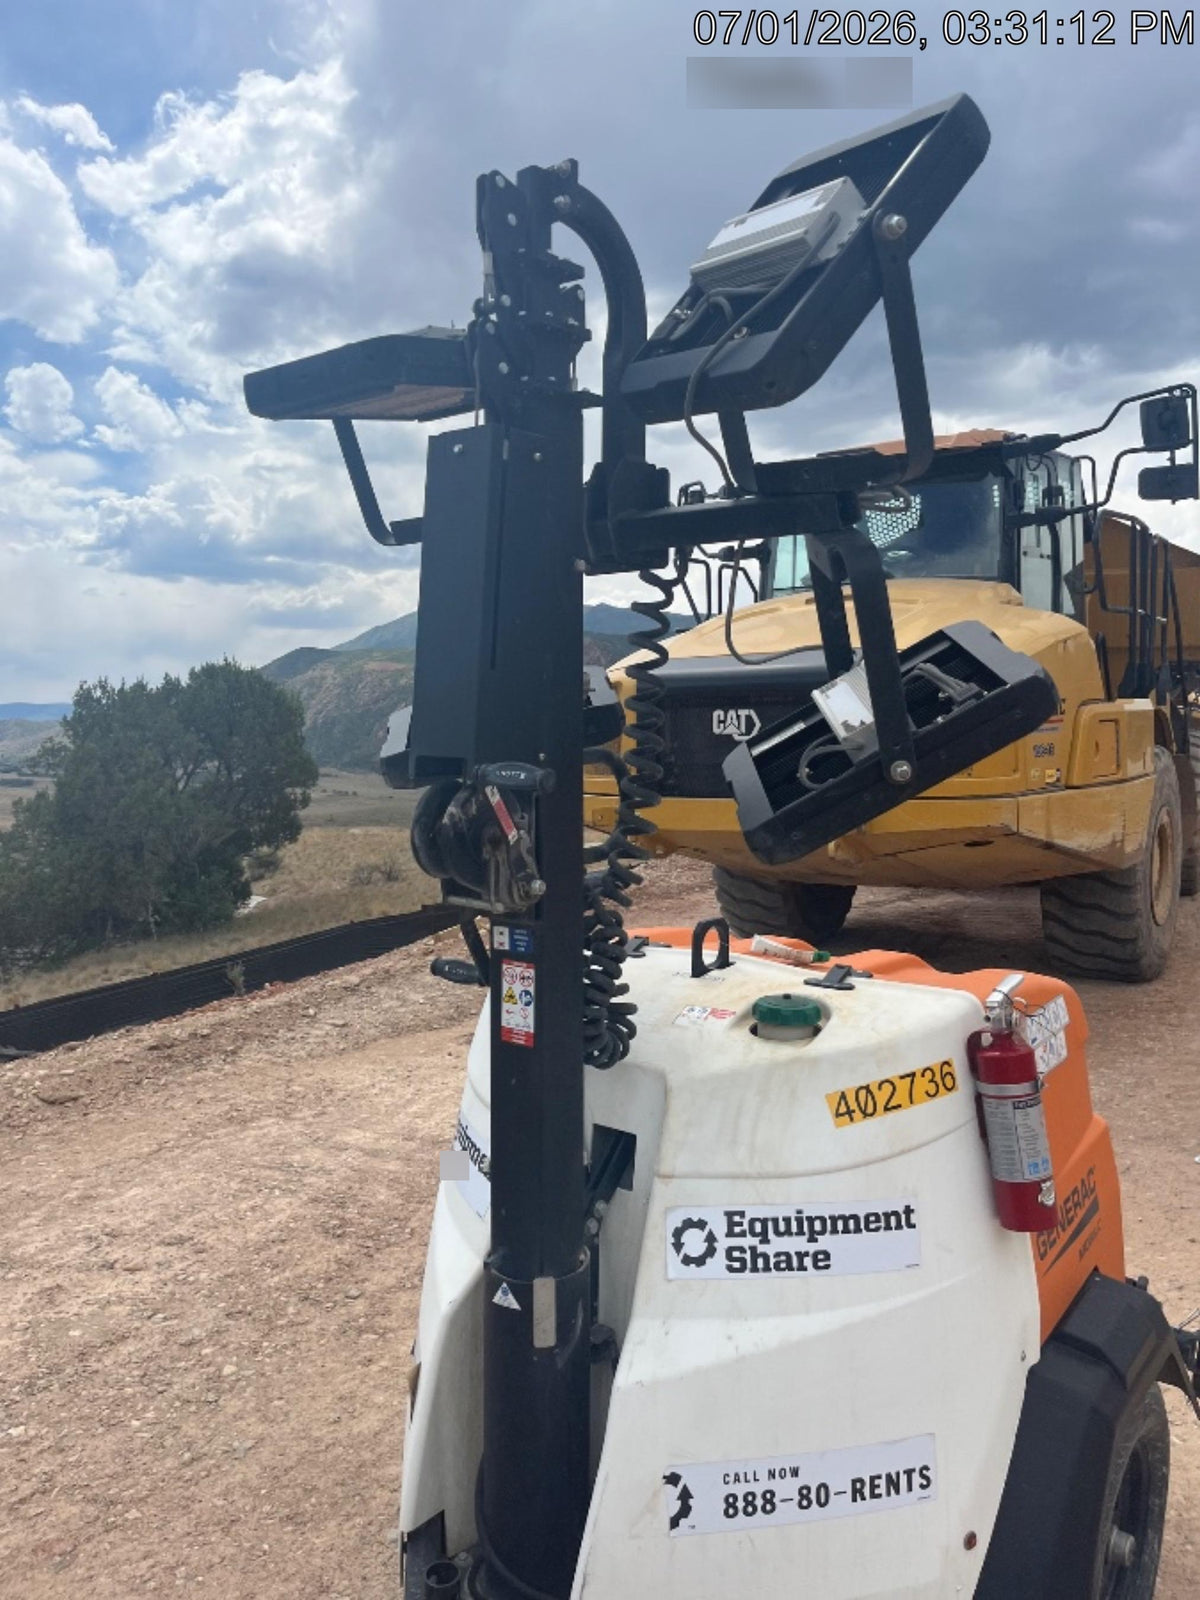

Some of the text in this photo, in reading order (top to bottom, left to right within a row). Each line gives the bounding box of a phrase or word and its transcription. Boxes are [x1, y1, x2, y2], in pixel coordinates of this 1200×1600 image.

[712, 708, 750, 735] CAT
[834, 1060, 957, 1123] 402736
[723, 1204, 917, 1245] Equipment
[1036, 1165, 1097, 1262] GENERAC
[724, 1246, 832, 1274] Share
[722, 1465, 800, 1486] CALL NOW
[722, 1464, 932, 1520] 888-80-RENTS
